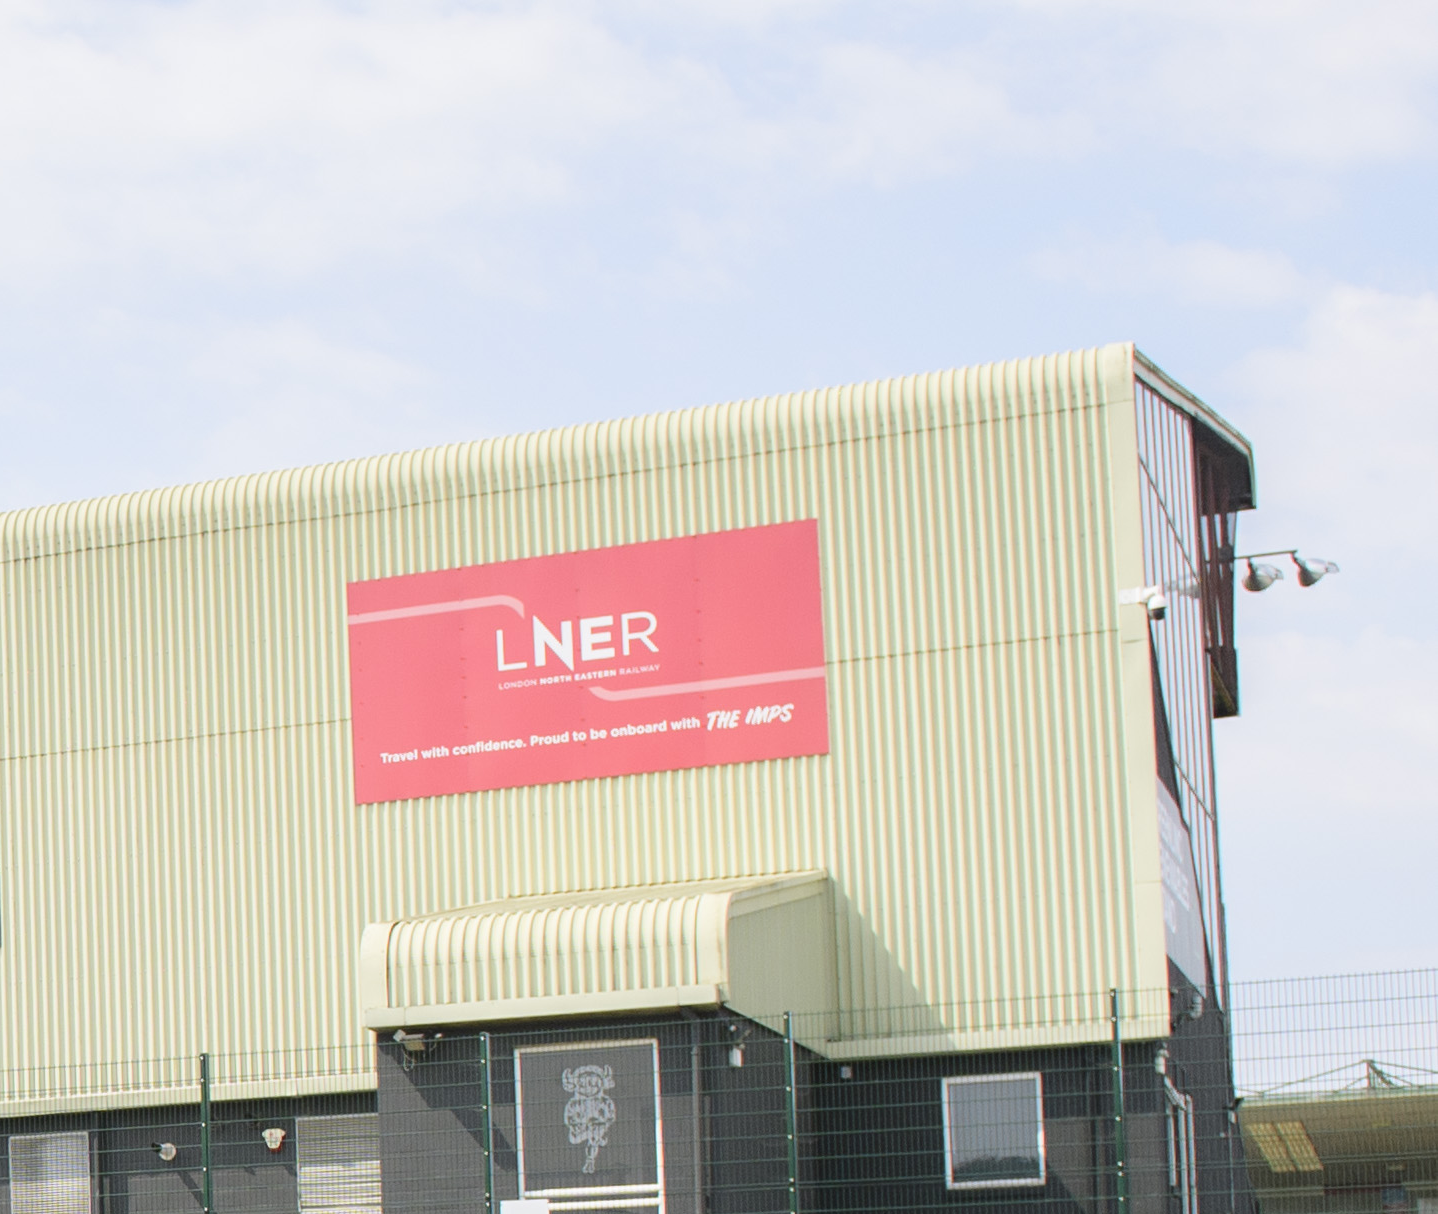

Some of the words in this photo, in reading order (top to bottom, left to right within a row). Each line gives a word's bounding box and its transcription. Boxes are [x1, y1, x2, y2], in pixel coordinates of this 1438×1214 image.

[496, 611, 660, 672] LNER
[498, 679, 537, 691] LONDON
[539, 674, 572, 686] NORTH
[574, 669, 617, 682] EASTERN
[619, 664, 661, 676] RAILWAY
[380, 749, 418, 764] Travel
[421, 745, 449, 759] with
[452, 737, 526, 756] confidence.
[530, 731, 569, 747] Proud
[571, 730, 587, 742] to
[590, 728, 607, 741] be
[610, 720, 667, 738] onboard
[670, 717, 700, 731] with
[706, 709, 741, 731] THE
[745, 703, 794, 726] IMPS
